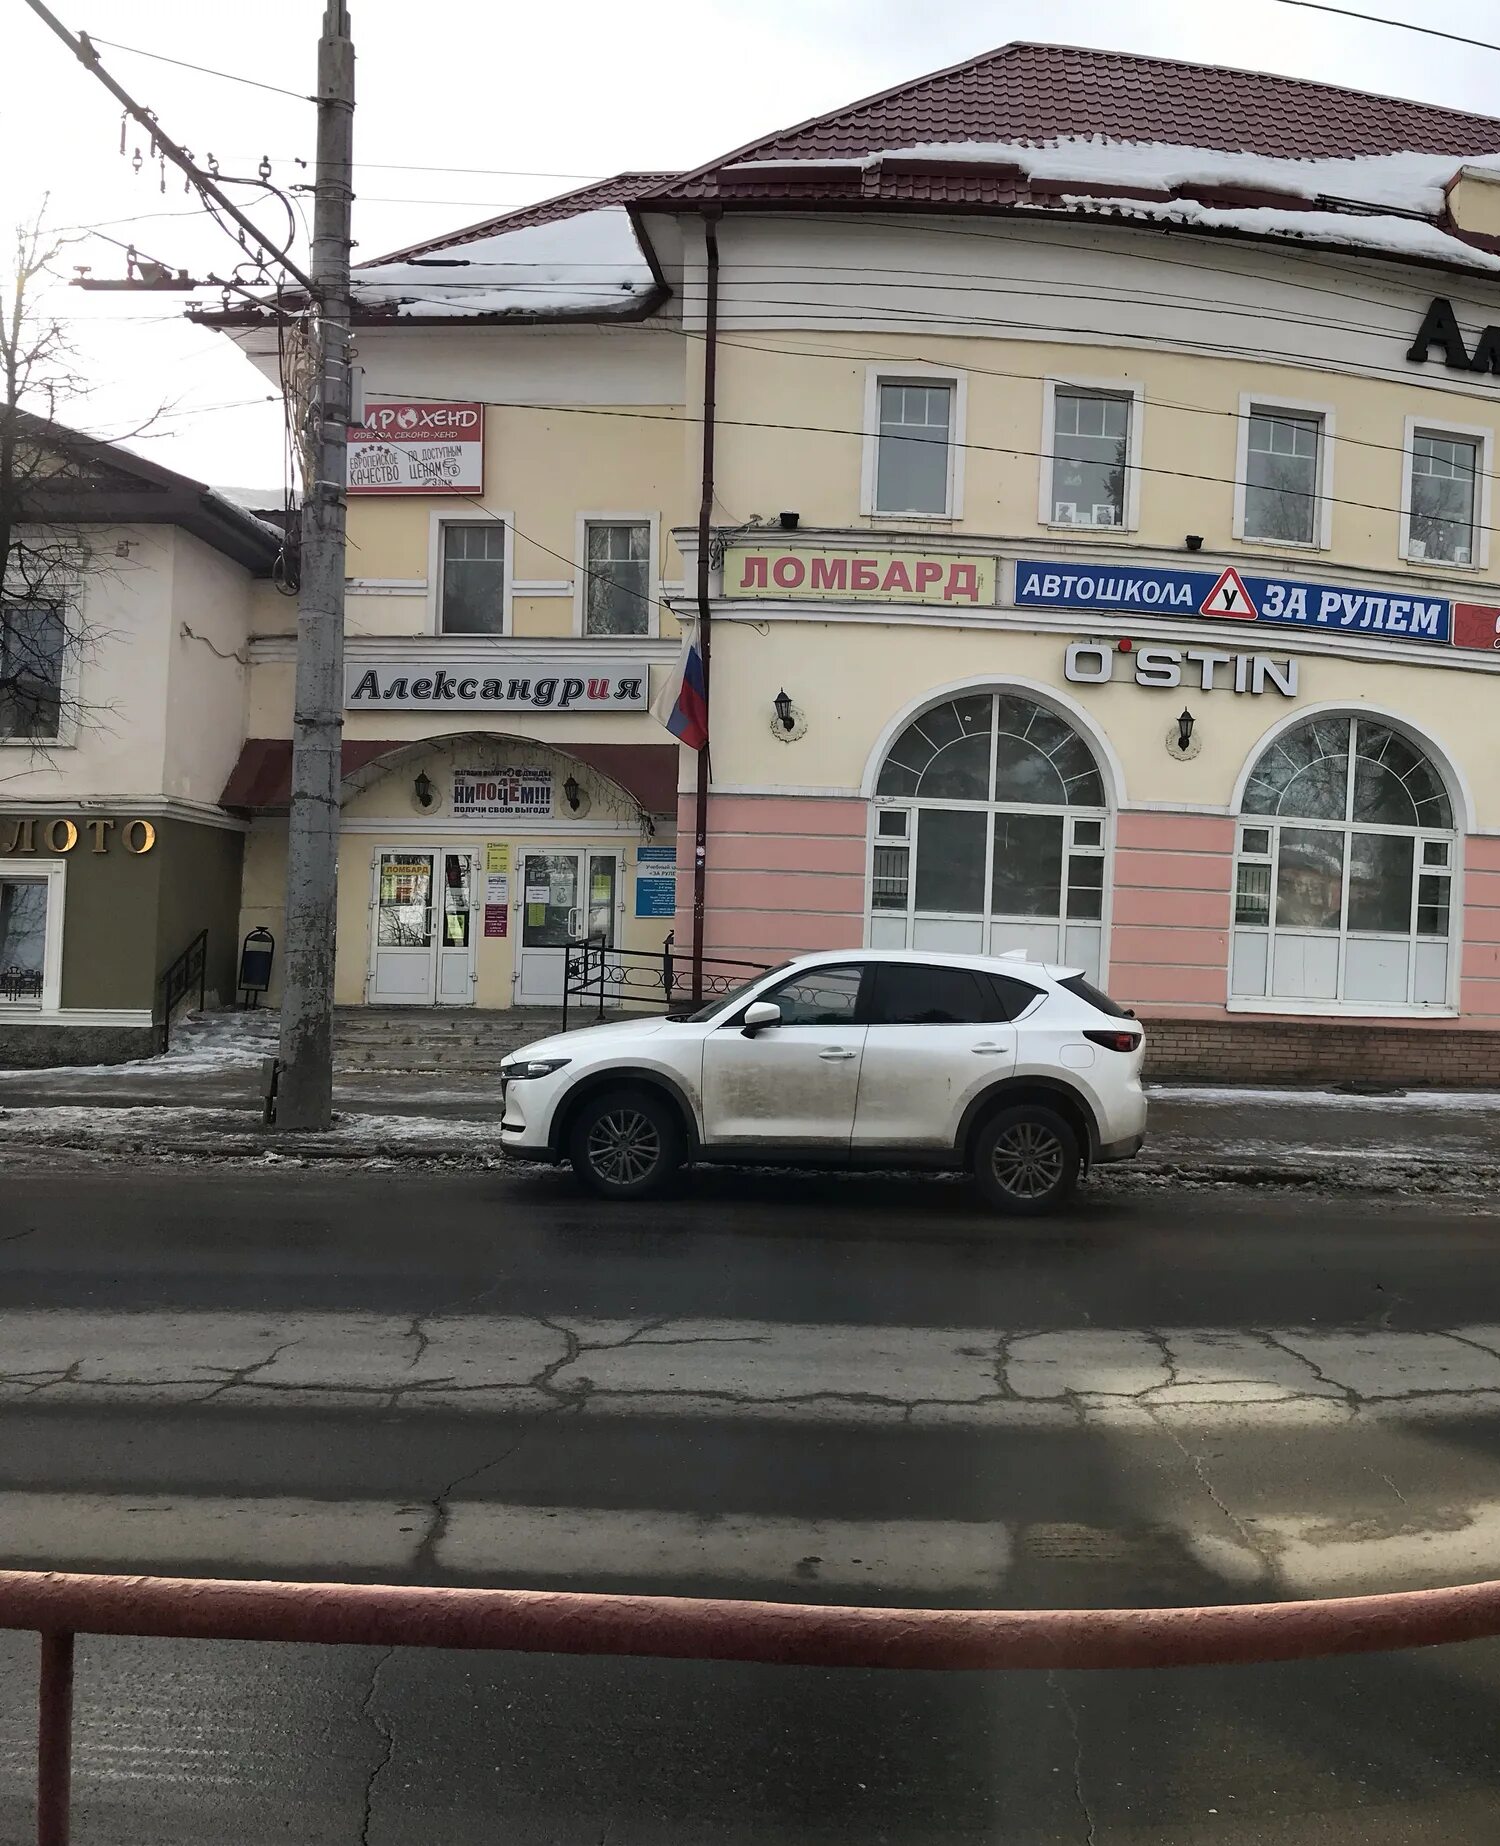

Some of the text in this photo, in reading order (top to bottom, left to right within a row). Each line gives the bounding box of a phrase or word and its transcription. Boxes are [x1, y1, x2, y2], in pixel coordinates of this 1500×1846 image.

[394, 431, 458, 439] СЕКОНД-ХЕНД
[350, 461, 444, 486] КАЧЕСТВО ЦЕНАМ
[740, 556, 979, 603] ЛОМБАРД
[1022, 573, 1194, 606] АВТОШКОЛА
[1262, 584, 1307, 621] ЗА
[1316, 590, 1441, 635] РУЛЕМ
[351, 669, 642, 707] Александрия
[454, 806, 550, 814] ПОЛУЧИ СВОЮ ВЫГОДУ
[386, 866, 429, 874] ЛОМБАРД
